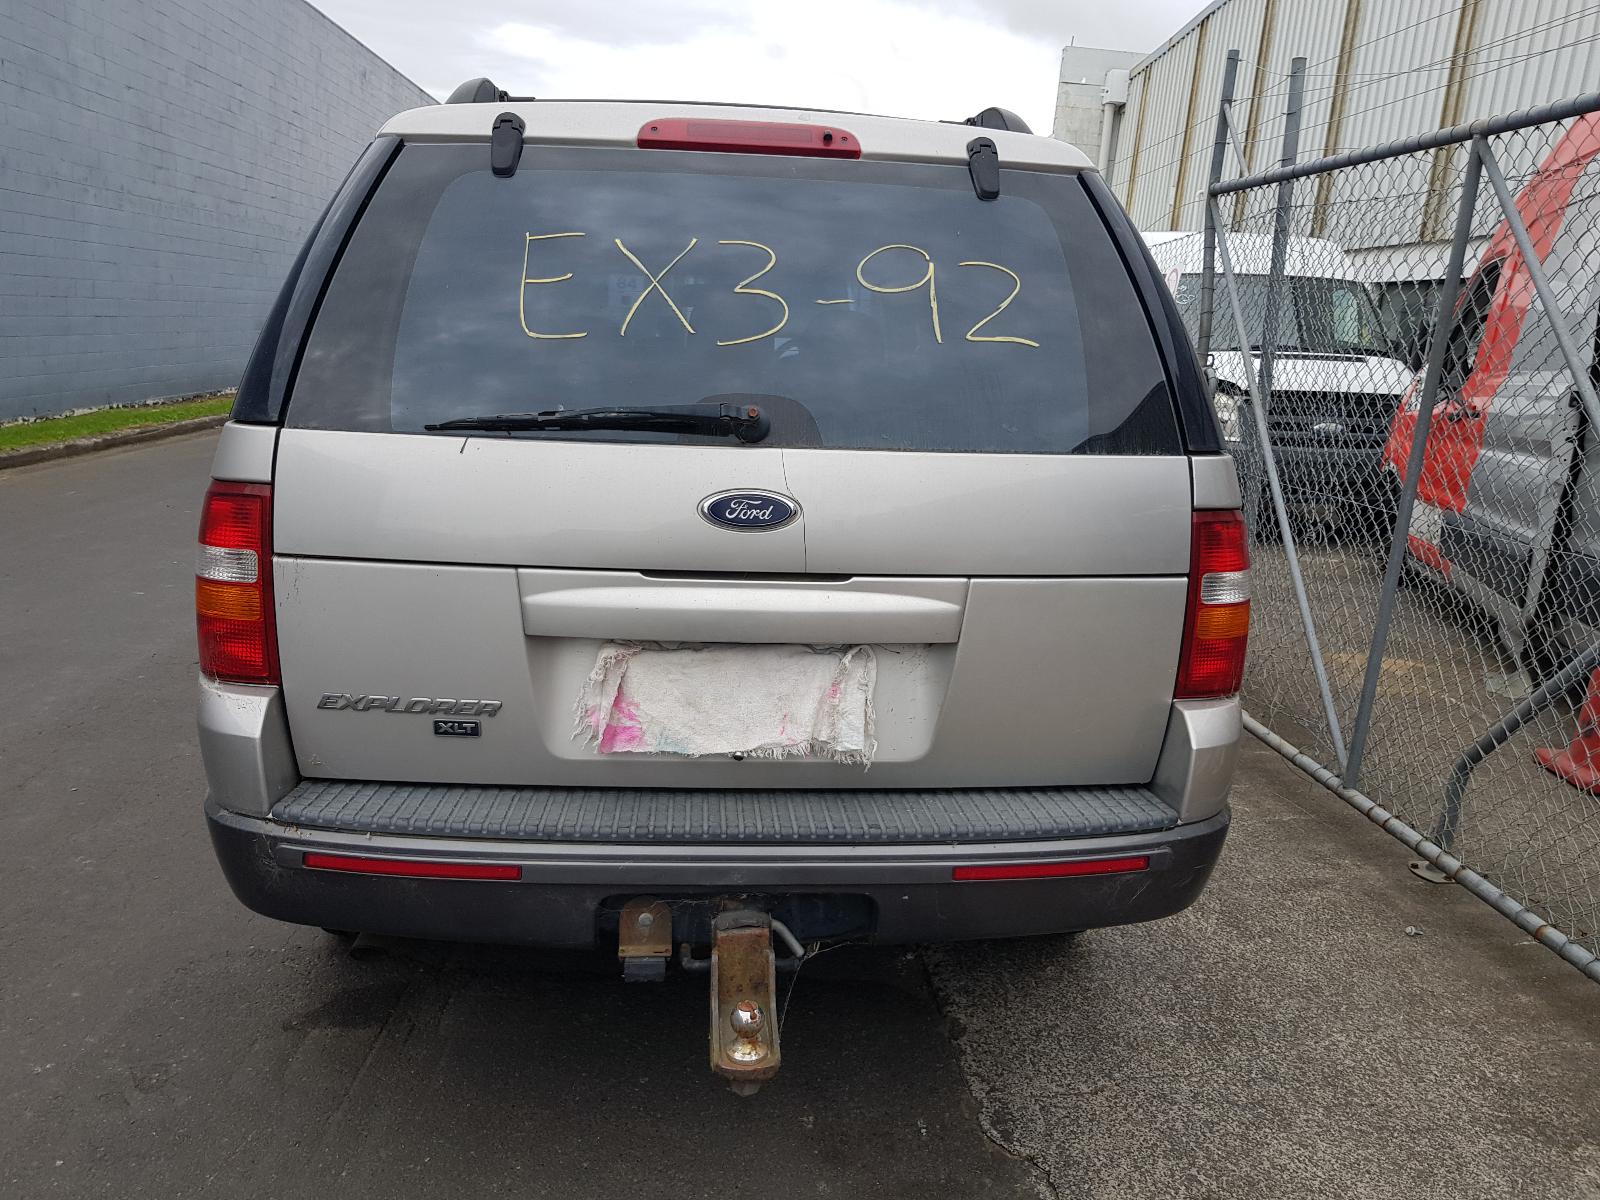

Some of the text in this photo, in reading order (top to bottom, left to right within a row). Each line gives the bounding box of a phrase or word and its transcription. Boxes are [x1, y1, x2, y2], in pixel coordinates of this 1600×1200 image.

[519, 232, 1040, 347] EX3-92
[725, 499, 774, 520] Ford
[317, 692, 503, 717] EXPLORER
[437, 722, 477, 734] XLT
